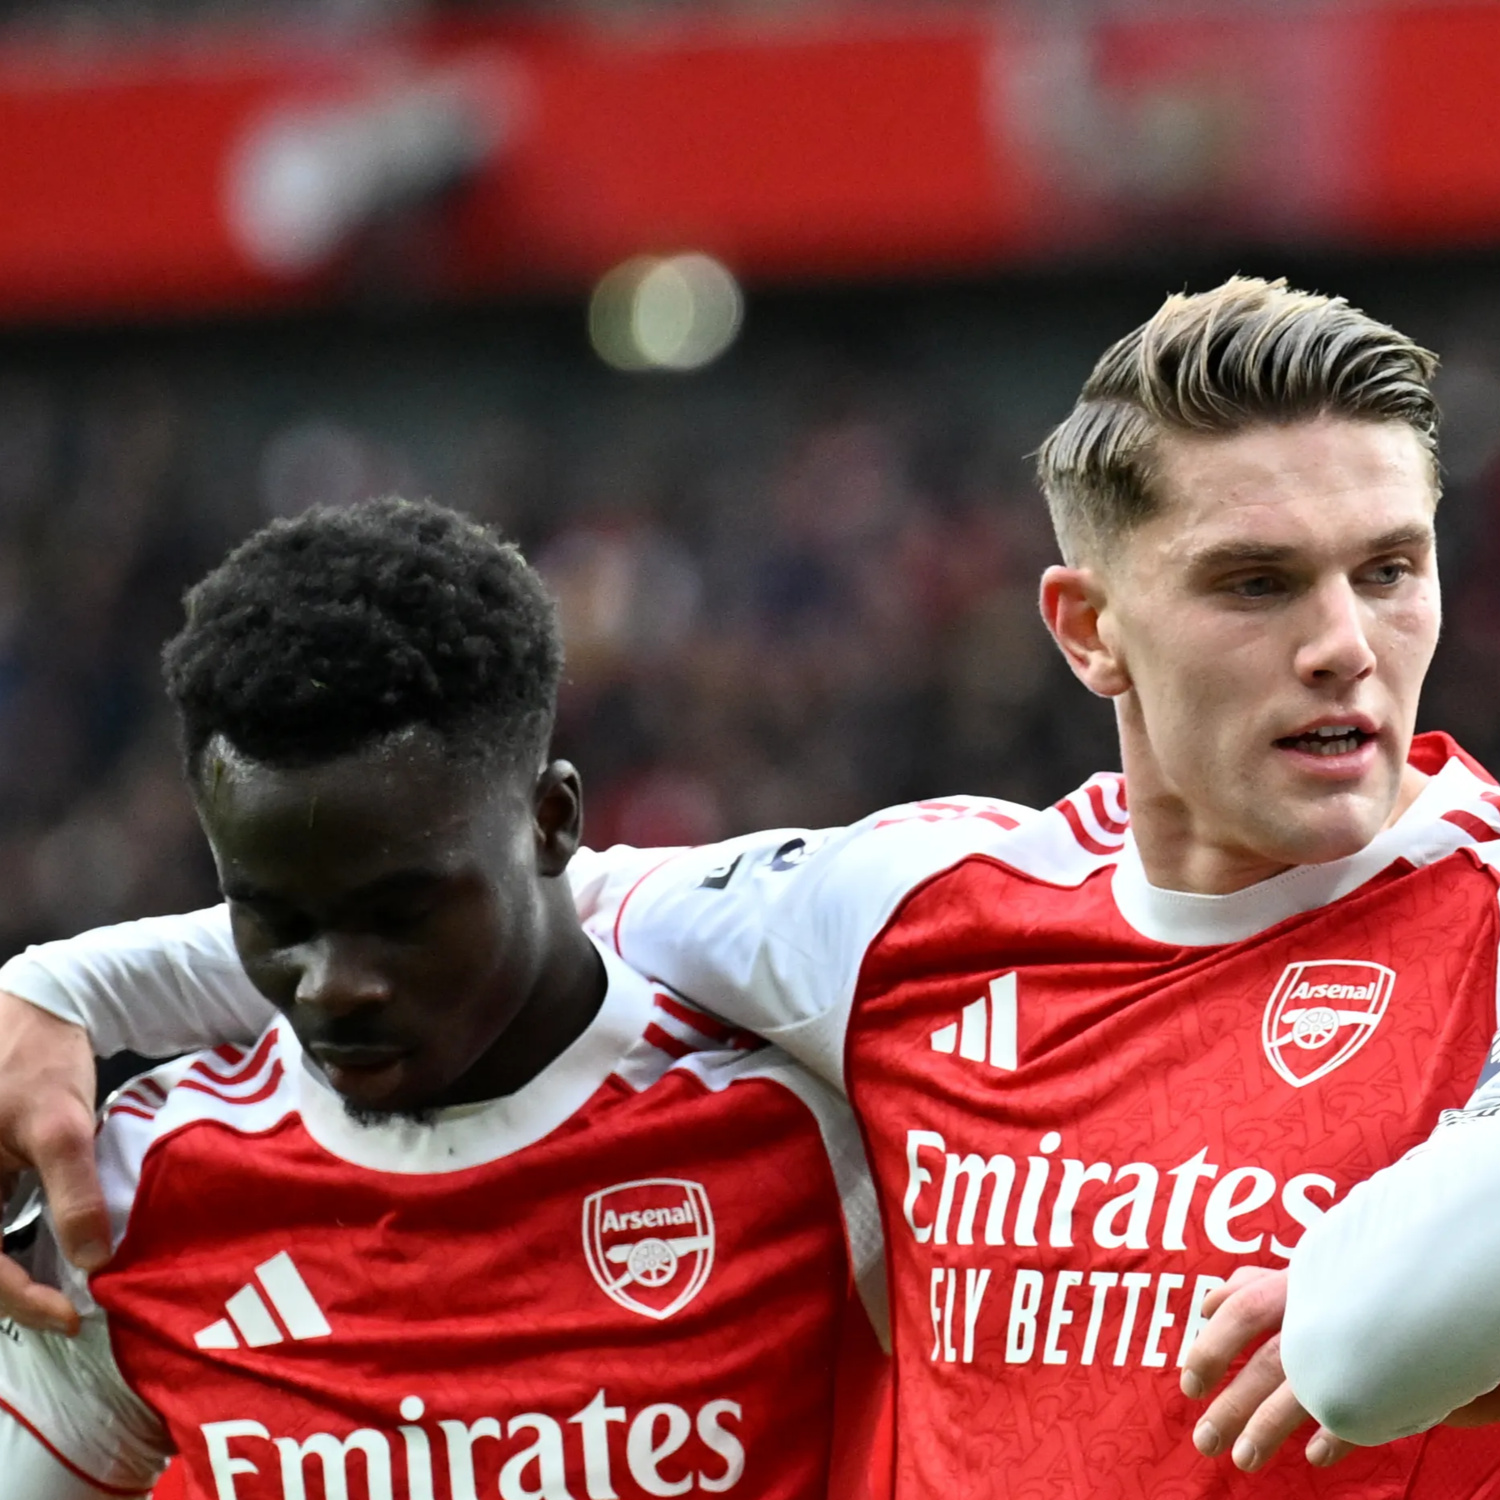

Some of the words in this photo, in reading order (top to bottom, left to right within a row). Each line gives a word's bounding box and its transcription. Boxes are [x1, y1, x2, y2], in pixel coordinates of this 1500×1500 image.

[1290, 982, 1376, 1000] Arsenal
[602, 1200, 693, 1233] Arsenal
[903, 1130, 1337, 1260] Emirates
[931, 1268, 992, 1362] FLY
